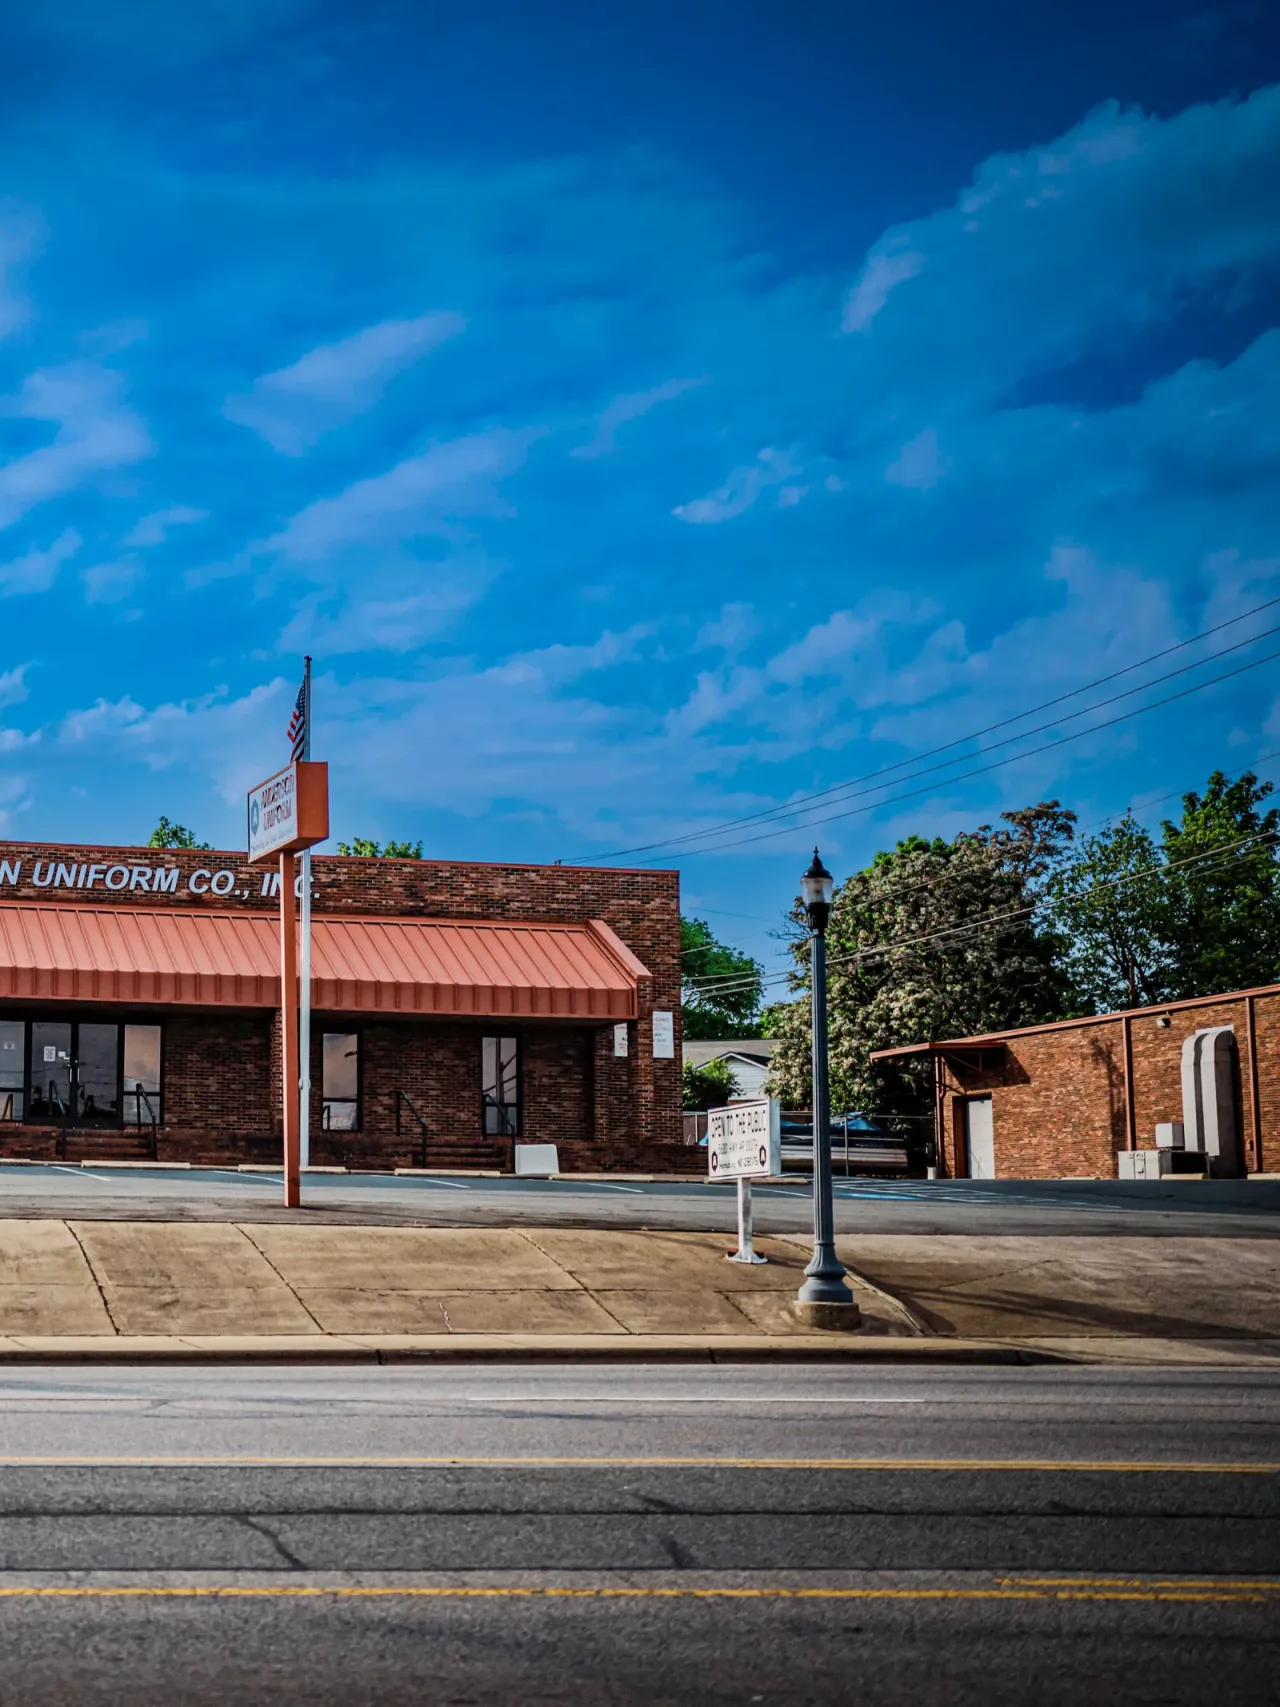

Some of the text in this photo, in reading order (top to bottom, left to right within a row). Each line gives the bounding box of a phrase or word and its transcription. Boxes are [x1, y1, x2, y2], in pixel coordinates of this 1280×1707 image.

[32, 860, 180, 893] UNIFORM
[188, 869, 249, 901] CO.,
[711, 1109, 767, 1138] OPEN TO THE PUBLIC
